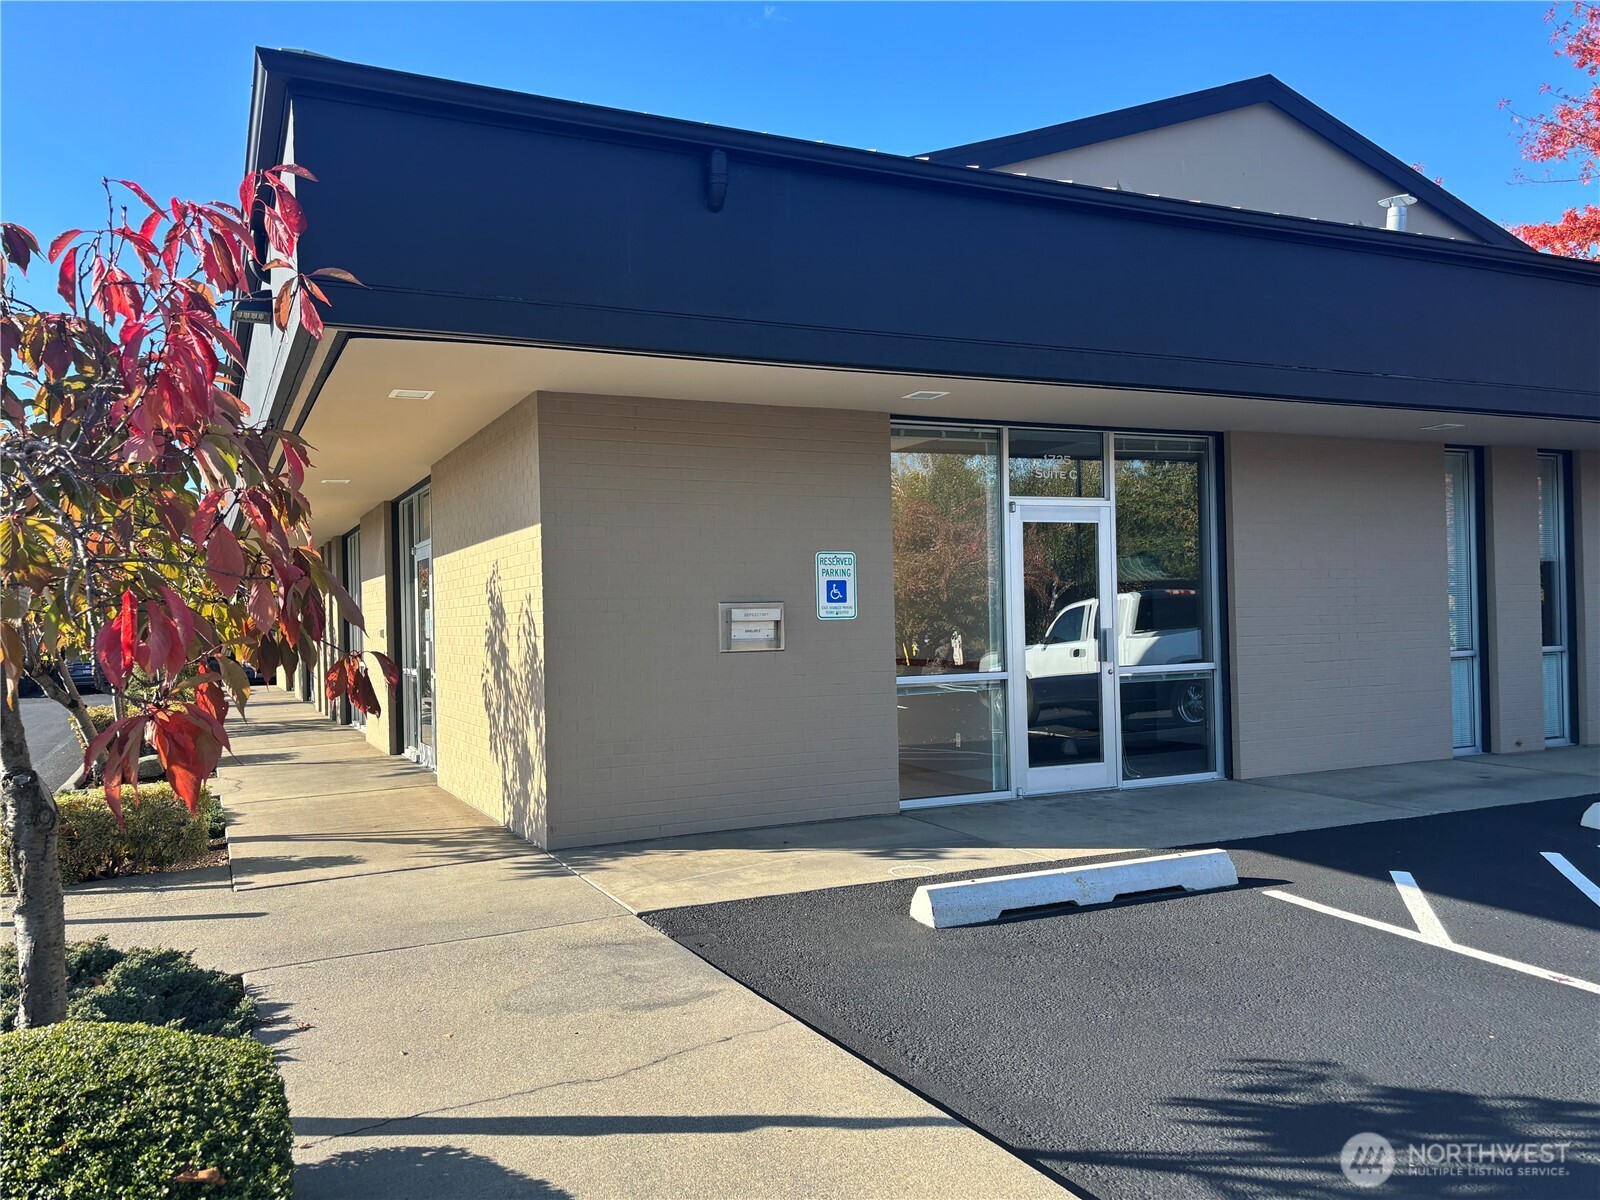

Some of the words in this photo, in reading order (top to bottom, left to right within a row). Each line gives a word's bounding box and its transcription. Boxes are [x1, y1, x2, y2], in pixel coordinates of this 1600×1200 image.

[1043, 454, 1071, 465] 1725
[1069, 470, 1078, 480] C
[819, 557, 853, 566] RESERVED
[821, 568, 852, 577] PARKING
